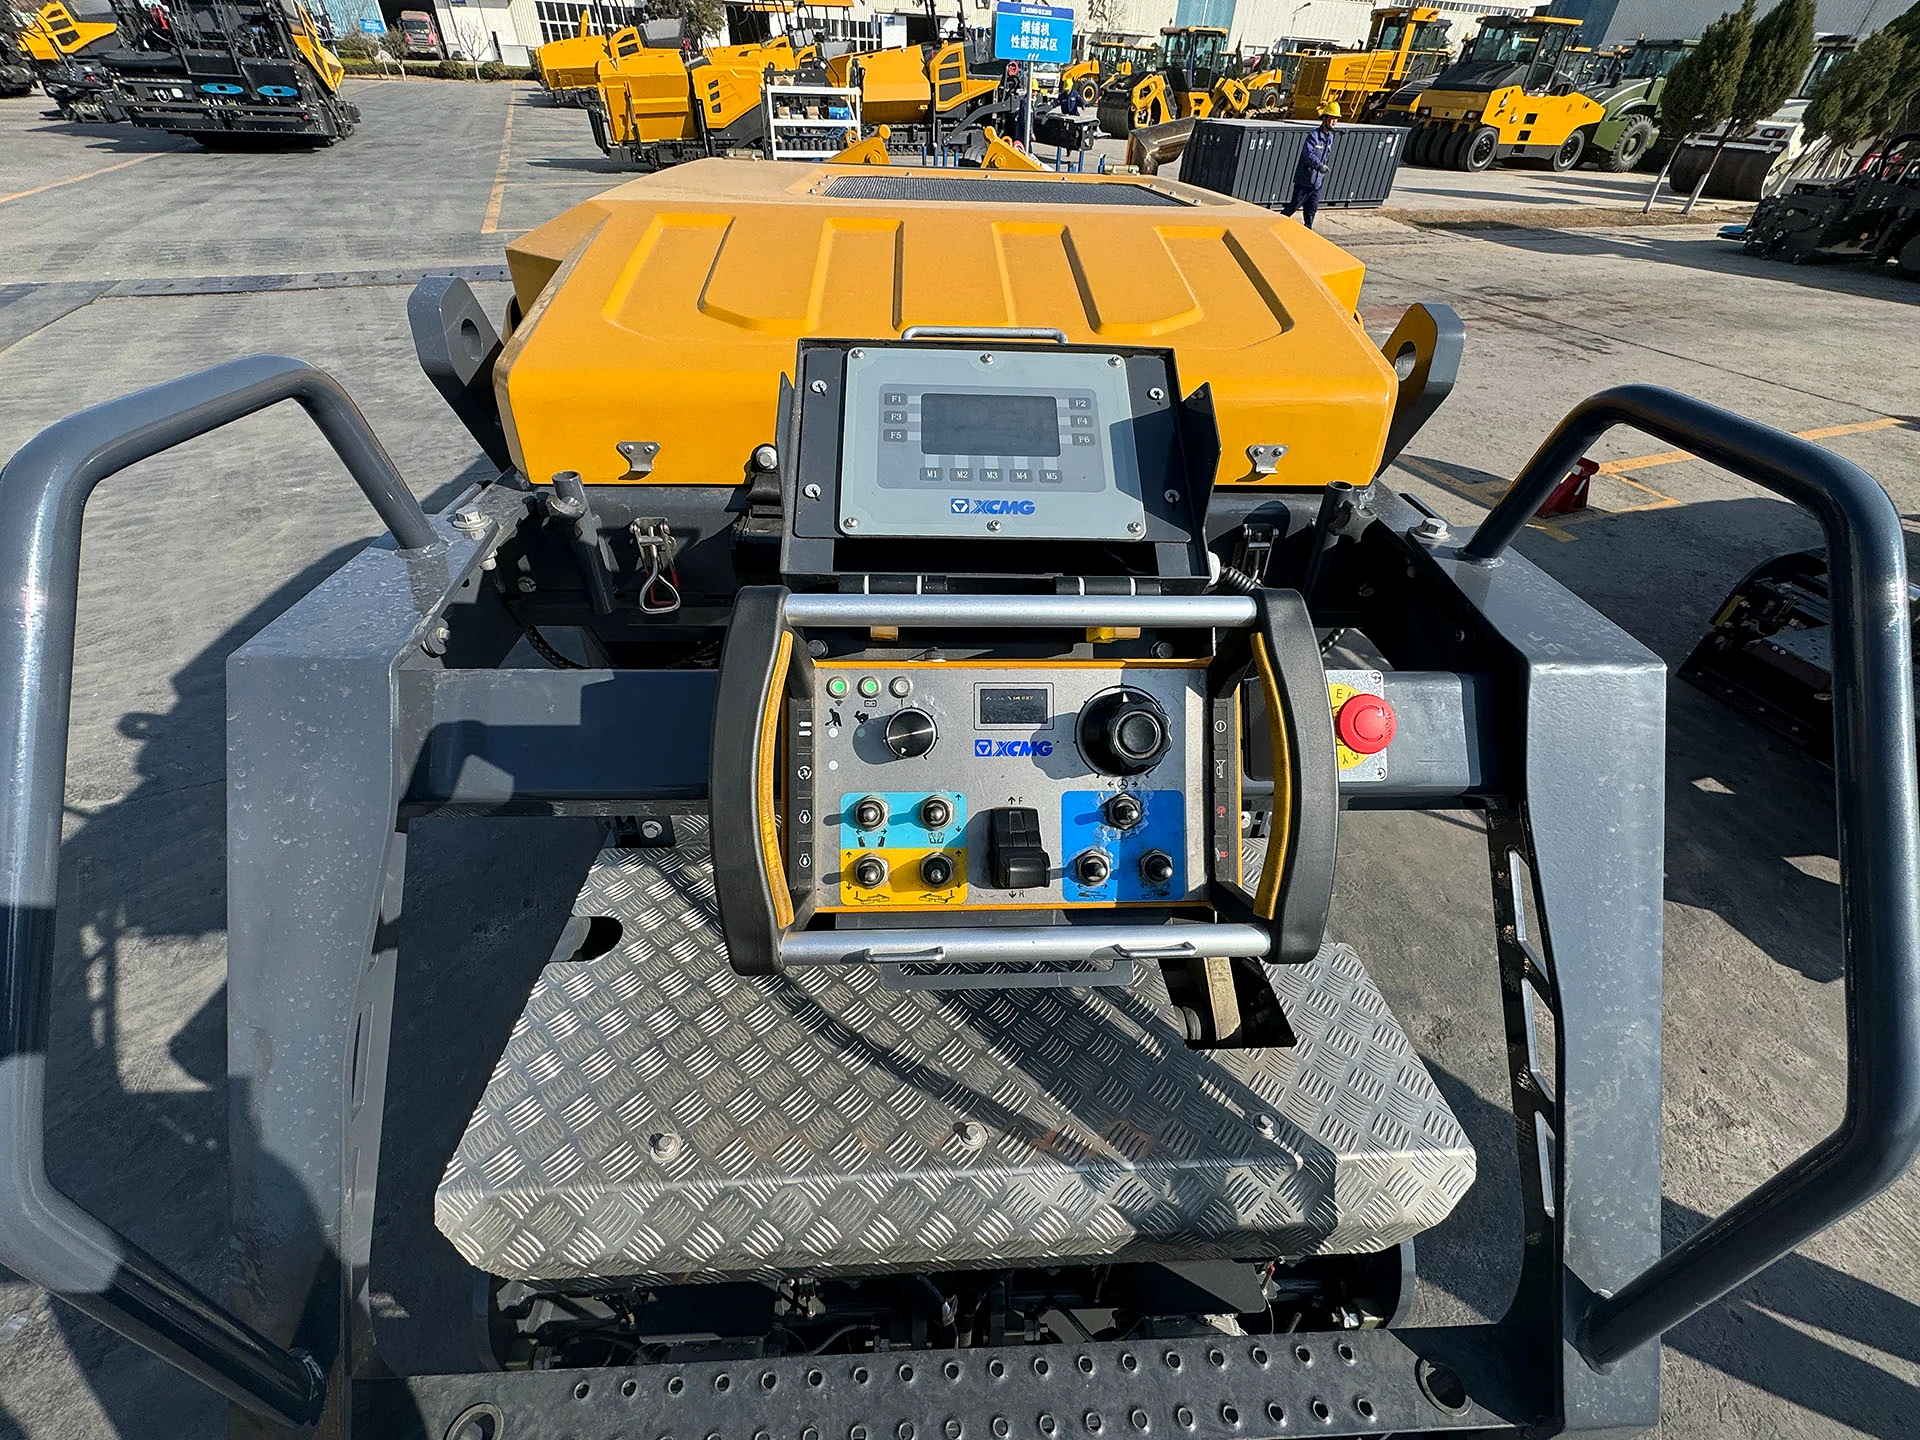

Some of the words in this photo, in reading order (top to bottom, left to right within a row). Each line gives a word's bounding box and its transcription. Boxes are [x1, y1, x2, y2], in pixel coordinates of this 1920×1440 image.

[1021, 20, 1050, 36] 摊铺机
[1011, 34, 1058, 51] 性能测试区
[891, 395, 902, 403] F1
[1075, 399, 1087, 408] F2
[890, 413, 902, 421] F3
[1077, 417, 1088, 425] F4
[890, 431, 902, 440] F5
[1078, 435, 1090, 443] F6
[926, 469, 938, 478] M1
[956, 470, 969, 479] M2
[986, 470, 998, 479] M3
[1016, 471, 1028, 480] M4
[1045, 472, 1058, 480] M5
[970, 499, 1036, 515] XCMG
[993, 740, 1053, 757] XCMG
[1018, 796, 1024, 805] F
[1018, 889, 1025, 898] R
